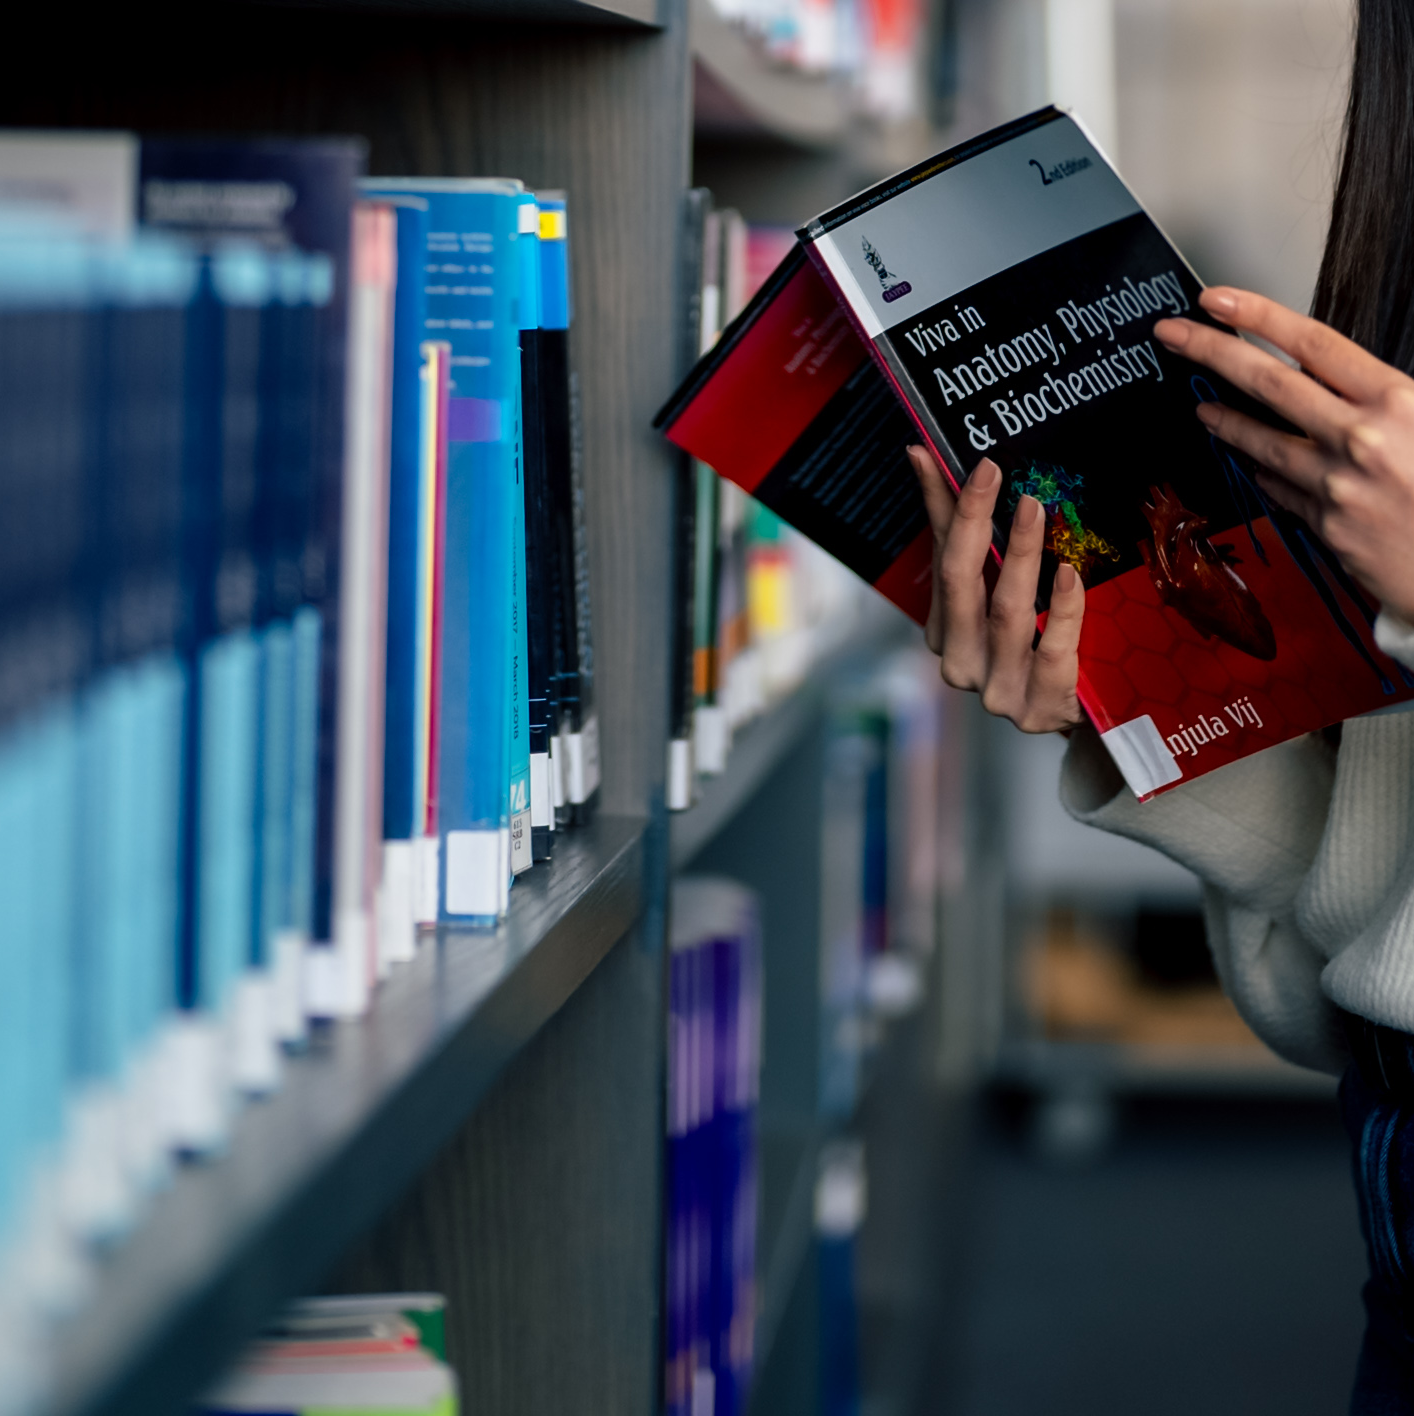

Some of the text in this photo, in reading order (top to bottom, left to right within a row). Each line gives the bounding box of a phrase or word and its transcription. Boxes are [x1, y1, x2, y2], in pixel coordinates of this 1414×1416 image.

[1060, 156, 1094, 178] Edition
[904, 304, 987, 357] Viva in
[933, 323, 1067, 406] Anatomy,
[1056, 270, 1191, 343] Physiology
[963, 413, 998, 451] &
[990, 340, 1164, 436] Biochemistry
[1166, 696, 1264, 758] njula Vij
